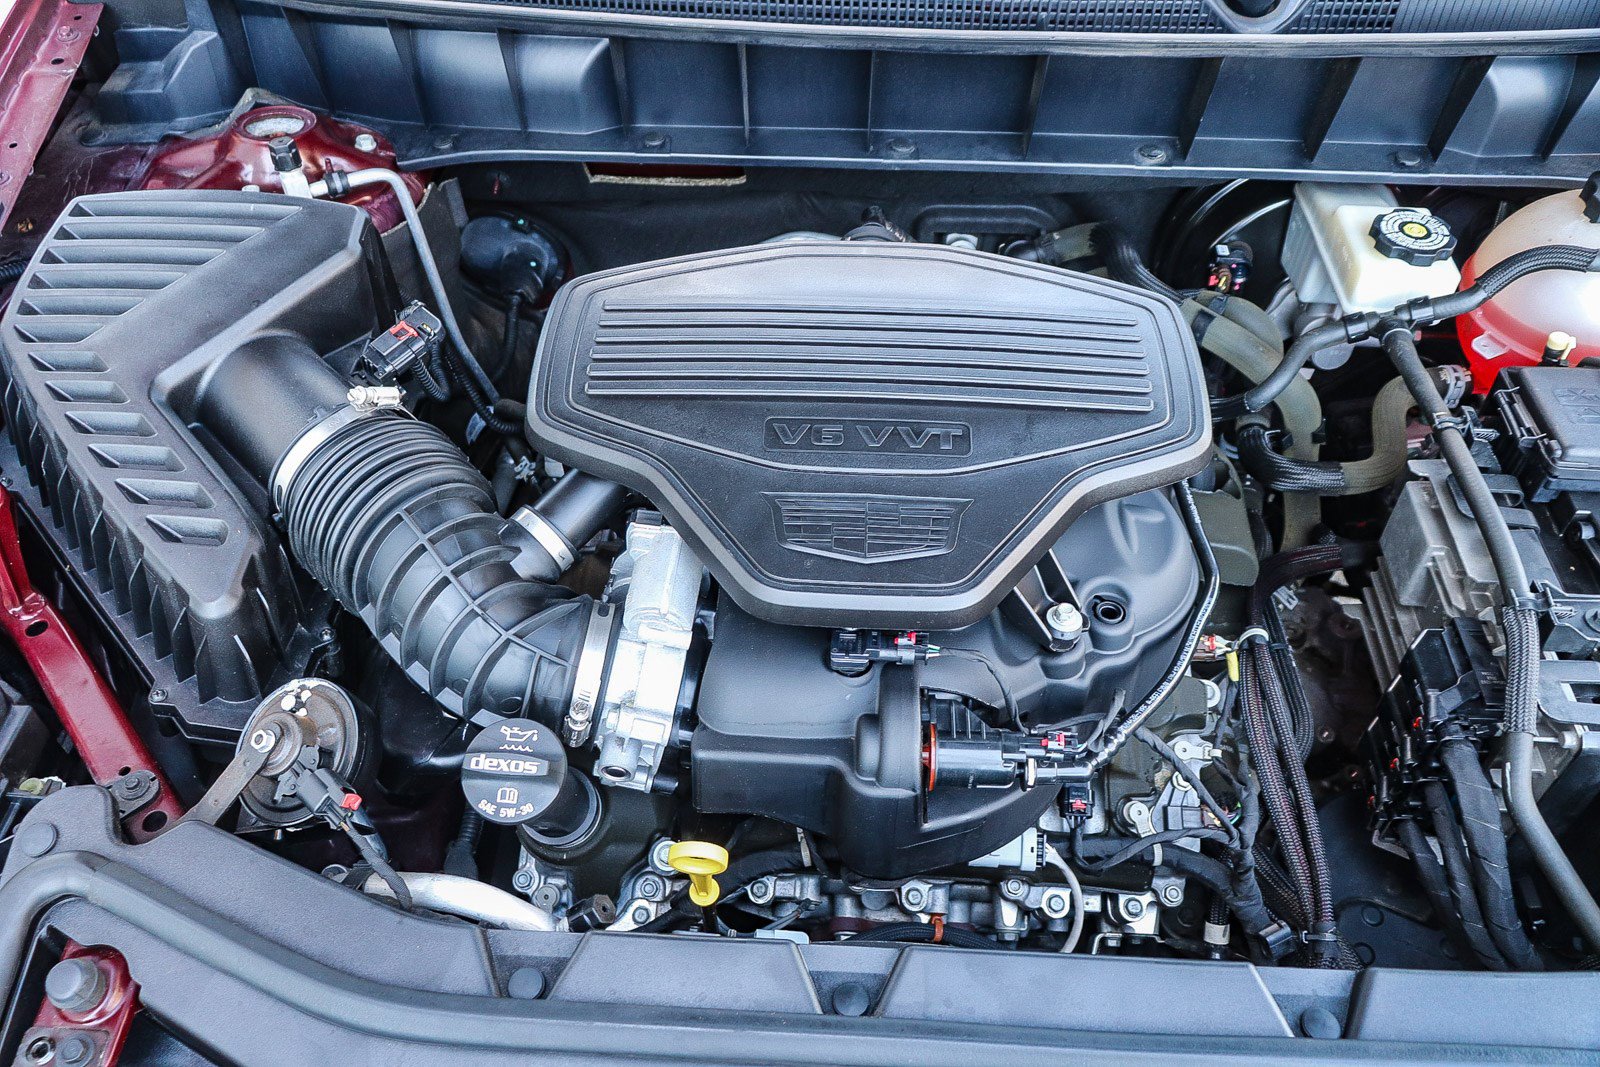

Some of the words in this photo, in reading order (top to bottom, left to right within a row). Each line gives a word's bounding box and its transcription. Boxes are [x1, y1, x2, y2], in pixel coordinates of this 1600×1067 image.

[772, 423, 845, 446] V6
[855, 425, 963, 450] VVT
[470, 753, 541, 775] dexos
[478, 799, 498, 816] SAE
[499, 802, 534, 818] 5W-30
